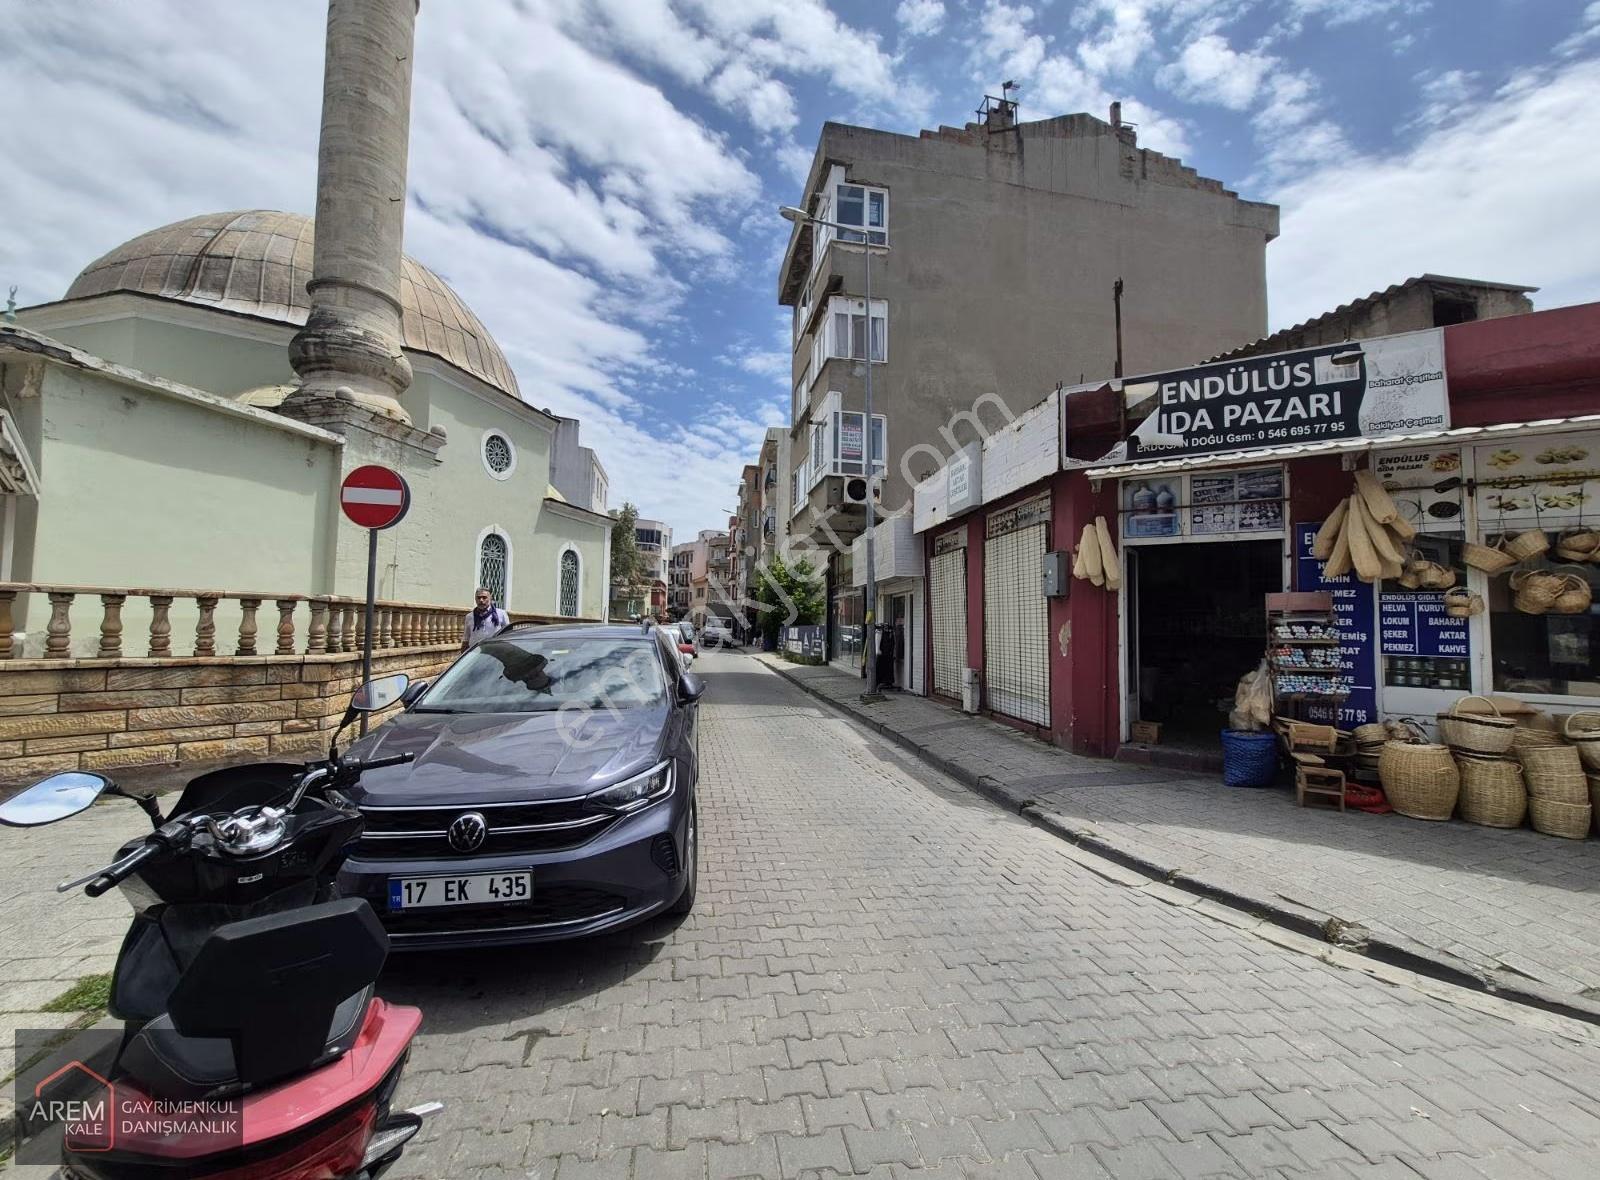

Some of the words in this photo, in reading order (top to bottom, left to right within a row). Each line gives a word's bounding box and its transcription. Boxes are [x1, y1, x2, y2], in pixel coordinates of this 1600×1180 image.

[1162, 360, 1312, 405] ENDÜLÜS
[1369, 376, 1404, 388] Baharat
[1405, 371, 1443, 385] Çeşitleri
[1161, 408, 1214, 434] IDA
[1224, 391, 1342, 428] PAZARI
[1405, 415, 1443, 428] Çeşitleri
[1191, 434, 1223, 447] DOĞU
[1226, 432, 1255, 444] Gsm:
[1258, 430, 1265, 440] 0
[1268, 428, 1288, 438] 546
[1290, 425, 1311, 436] 695
[1313, 423, 1328, 434] 77
[1330, 421, 1346, 432] 95
[1383, 604, 1407, 612] HELVA
[1419, 604, 1445, 612] KURUY
[1383, 617, 1410, 625] LOKUM
[1428, 617, 1465, 626] BAHARAT
[1383, 630, 1408, 639] ŞEKER
[1439, 631, 1466, 640] AKTAR
[1383, 643, 1414, 652] PEKMEZ
[1439, 644, 1466, 653] KAHVE
[1344, 708, 1355, 721] 77
[1356, 709, 1367, 722] 95
[404, 881, 428, 904] 17
[444, 879, 470, 902] EK
[488, 875, 527, 899] 435
